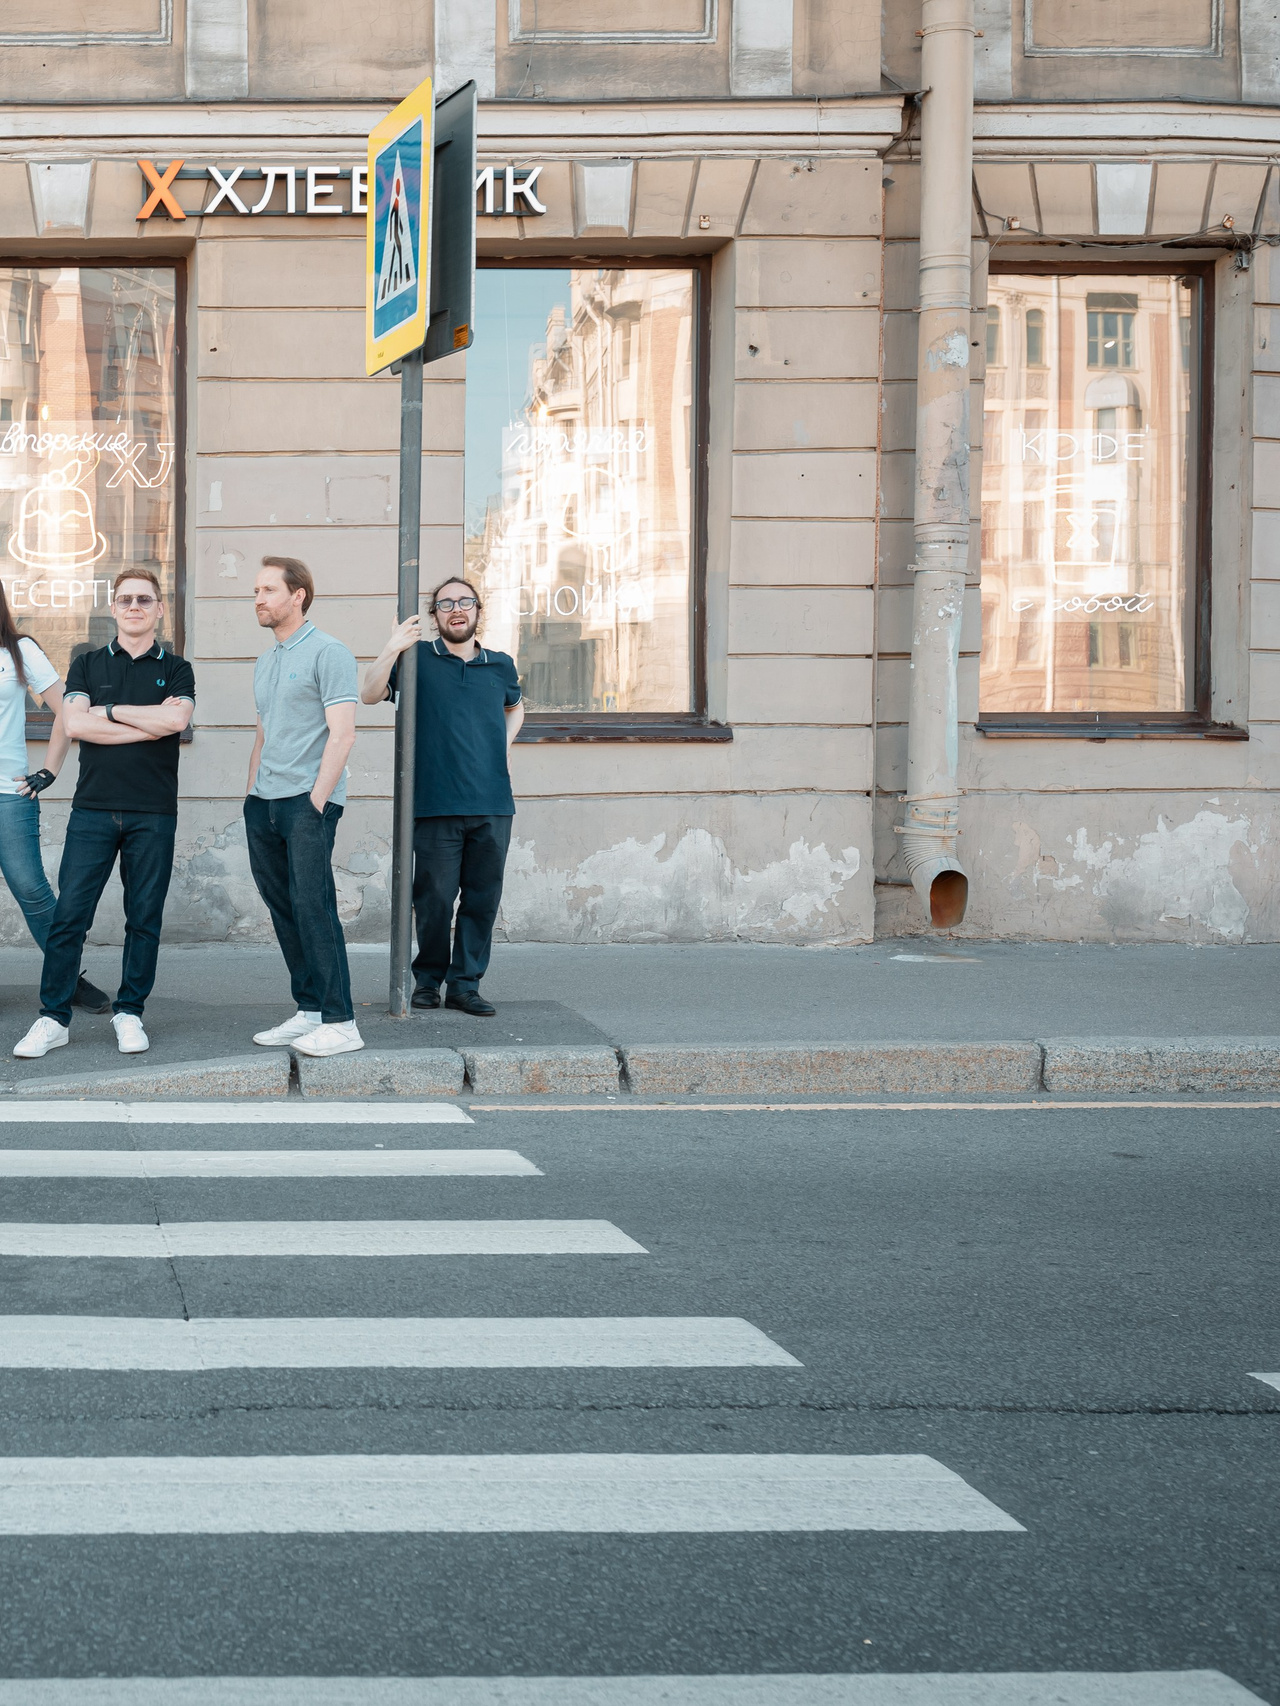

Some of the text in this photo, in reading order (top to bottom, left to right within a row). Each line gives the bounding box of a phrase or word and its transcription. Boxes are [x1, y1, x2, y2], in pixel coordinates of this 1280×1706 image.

[1022, 432, 1146, 463] КОФЕ
[508, 578, 649, 617] СЛОЙКА
[1046, 591, 1155, 614] собой
